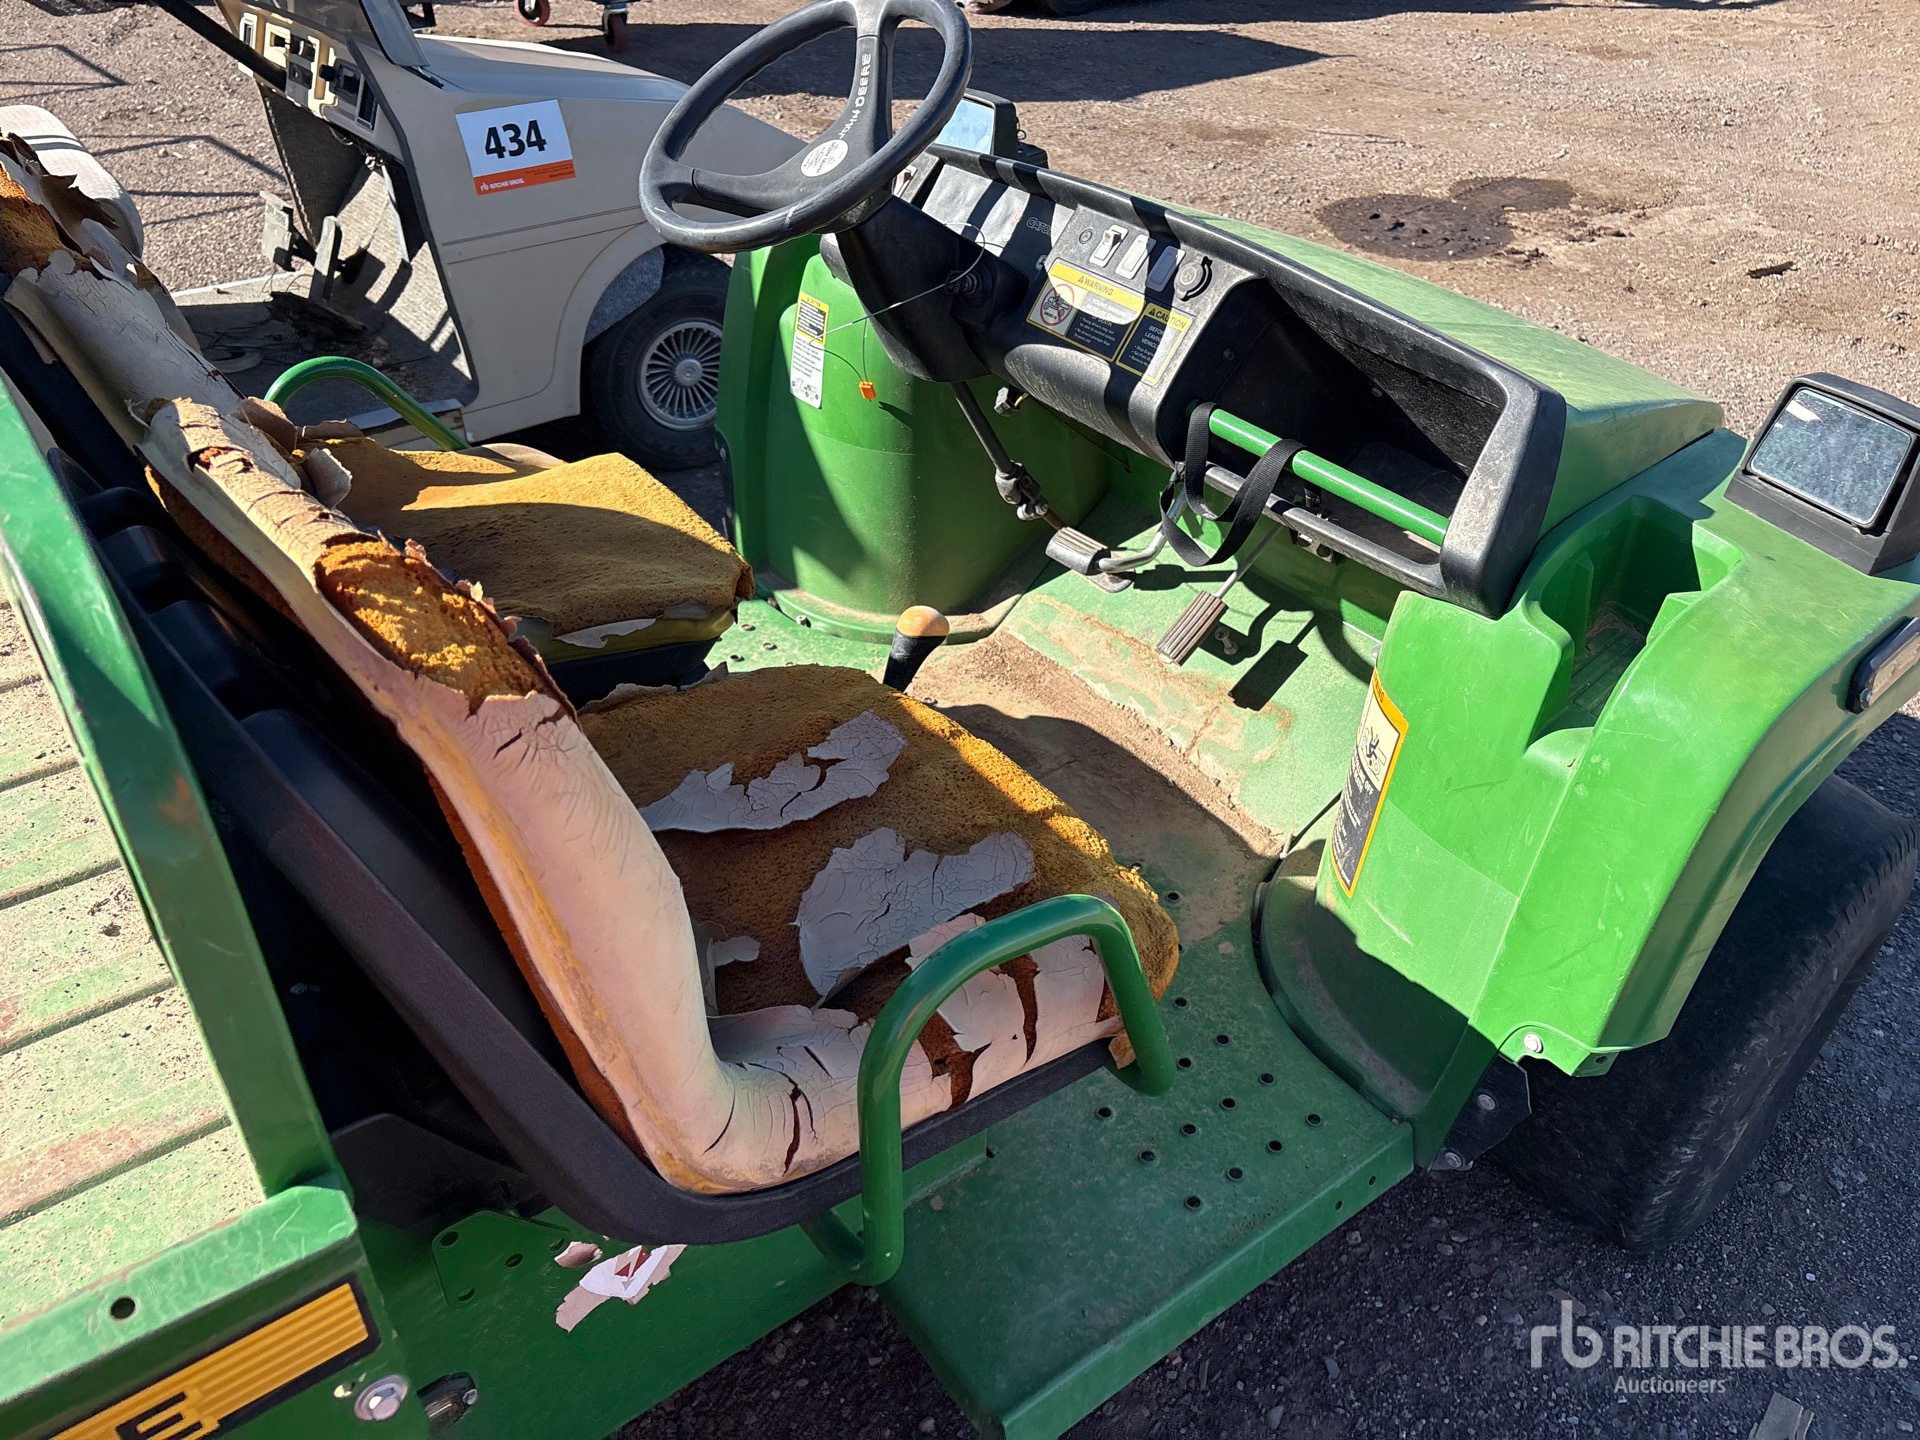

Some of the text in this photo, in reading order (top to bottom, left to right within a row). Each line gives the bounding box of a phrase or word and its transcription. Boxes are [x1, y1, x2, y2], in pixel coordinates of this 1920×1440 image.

[838, 53, 872, 140] JOHN DEERE
[485, 120, 547, 158] 434
[1083, 277, 1113, 296] WARNING
[1155, 310, 1186, 328] CAUTION
